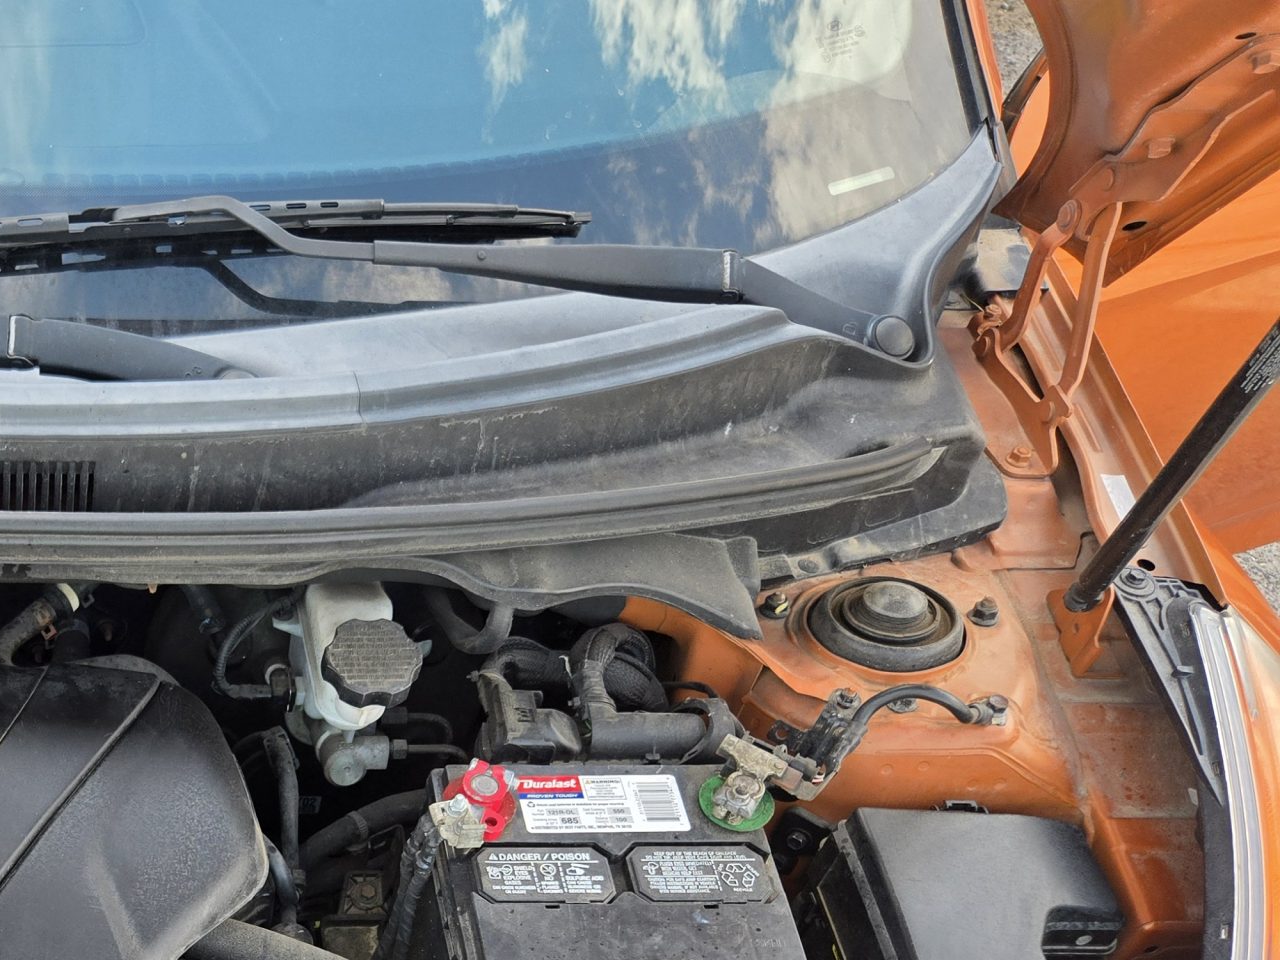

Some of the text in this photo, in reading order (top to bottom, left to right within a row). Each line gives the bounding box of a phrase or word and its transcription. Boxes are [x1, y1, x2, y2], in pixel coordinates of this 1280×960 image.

[518, 779, 577, 788] Duralast
[561, 817, 579, 825] 685
[498, 853, 540, 861] DANGER
[550, 853, 590, 861] POISON
